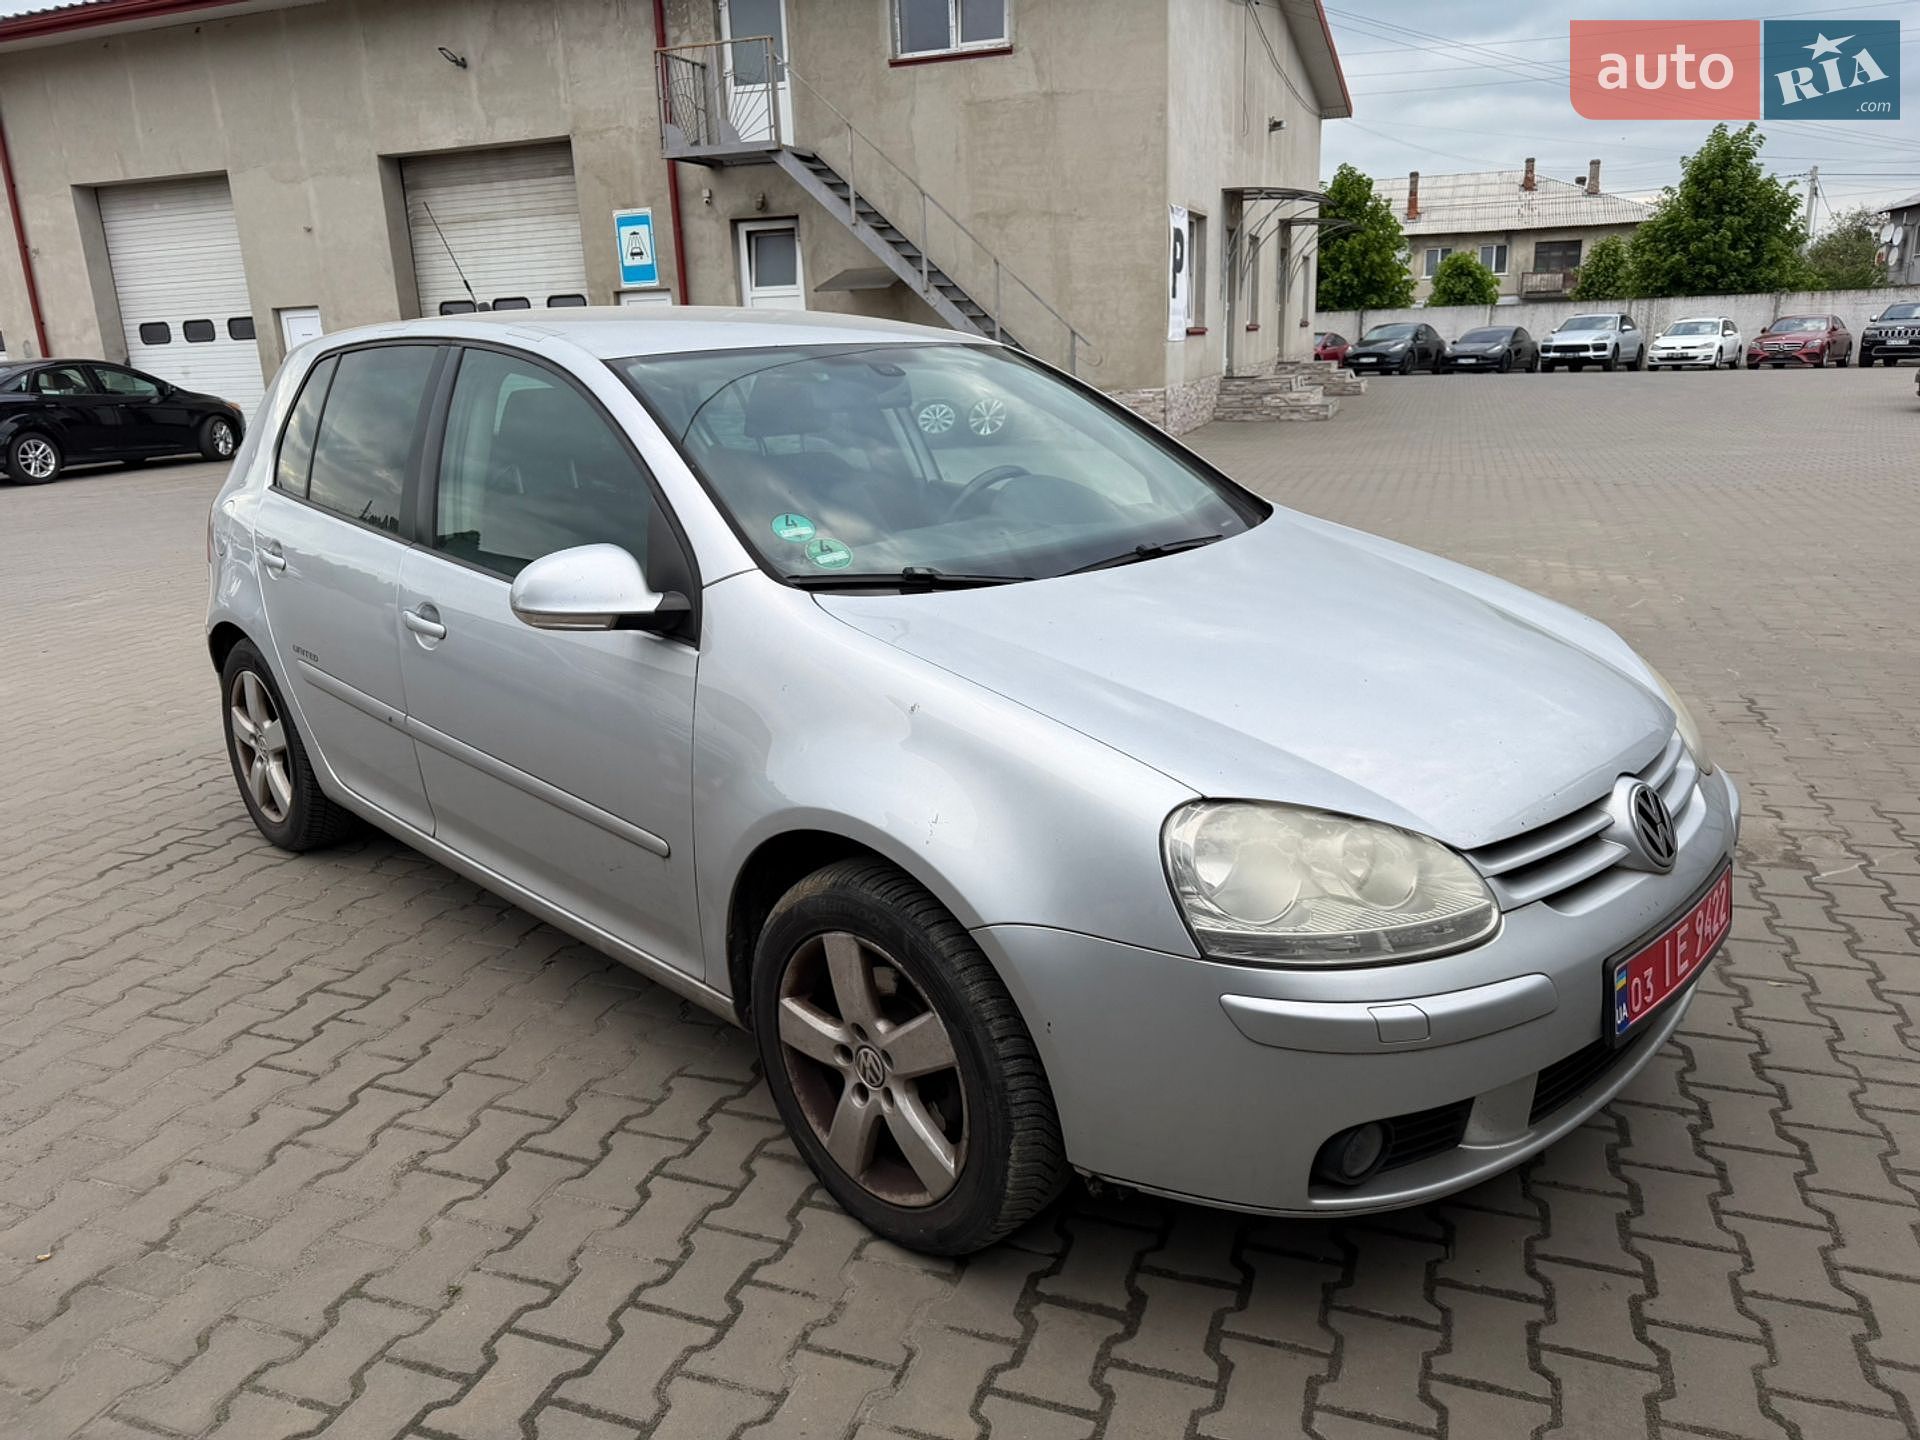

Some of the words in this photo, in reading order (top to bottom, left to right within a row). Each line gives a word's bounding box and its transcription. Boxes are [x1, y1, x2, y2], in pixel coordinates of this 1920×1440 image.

[1172, 227, 1184, 298] P
[292, 644, 319, 662] UNITED
[1631, 967, 1654, 1013] 03
[1665, 923, 1690, 988] IE
[1695, 880, 1728, 958] 9422
[1615, 1005, 1629, 1024] UA
